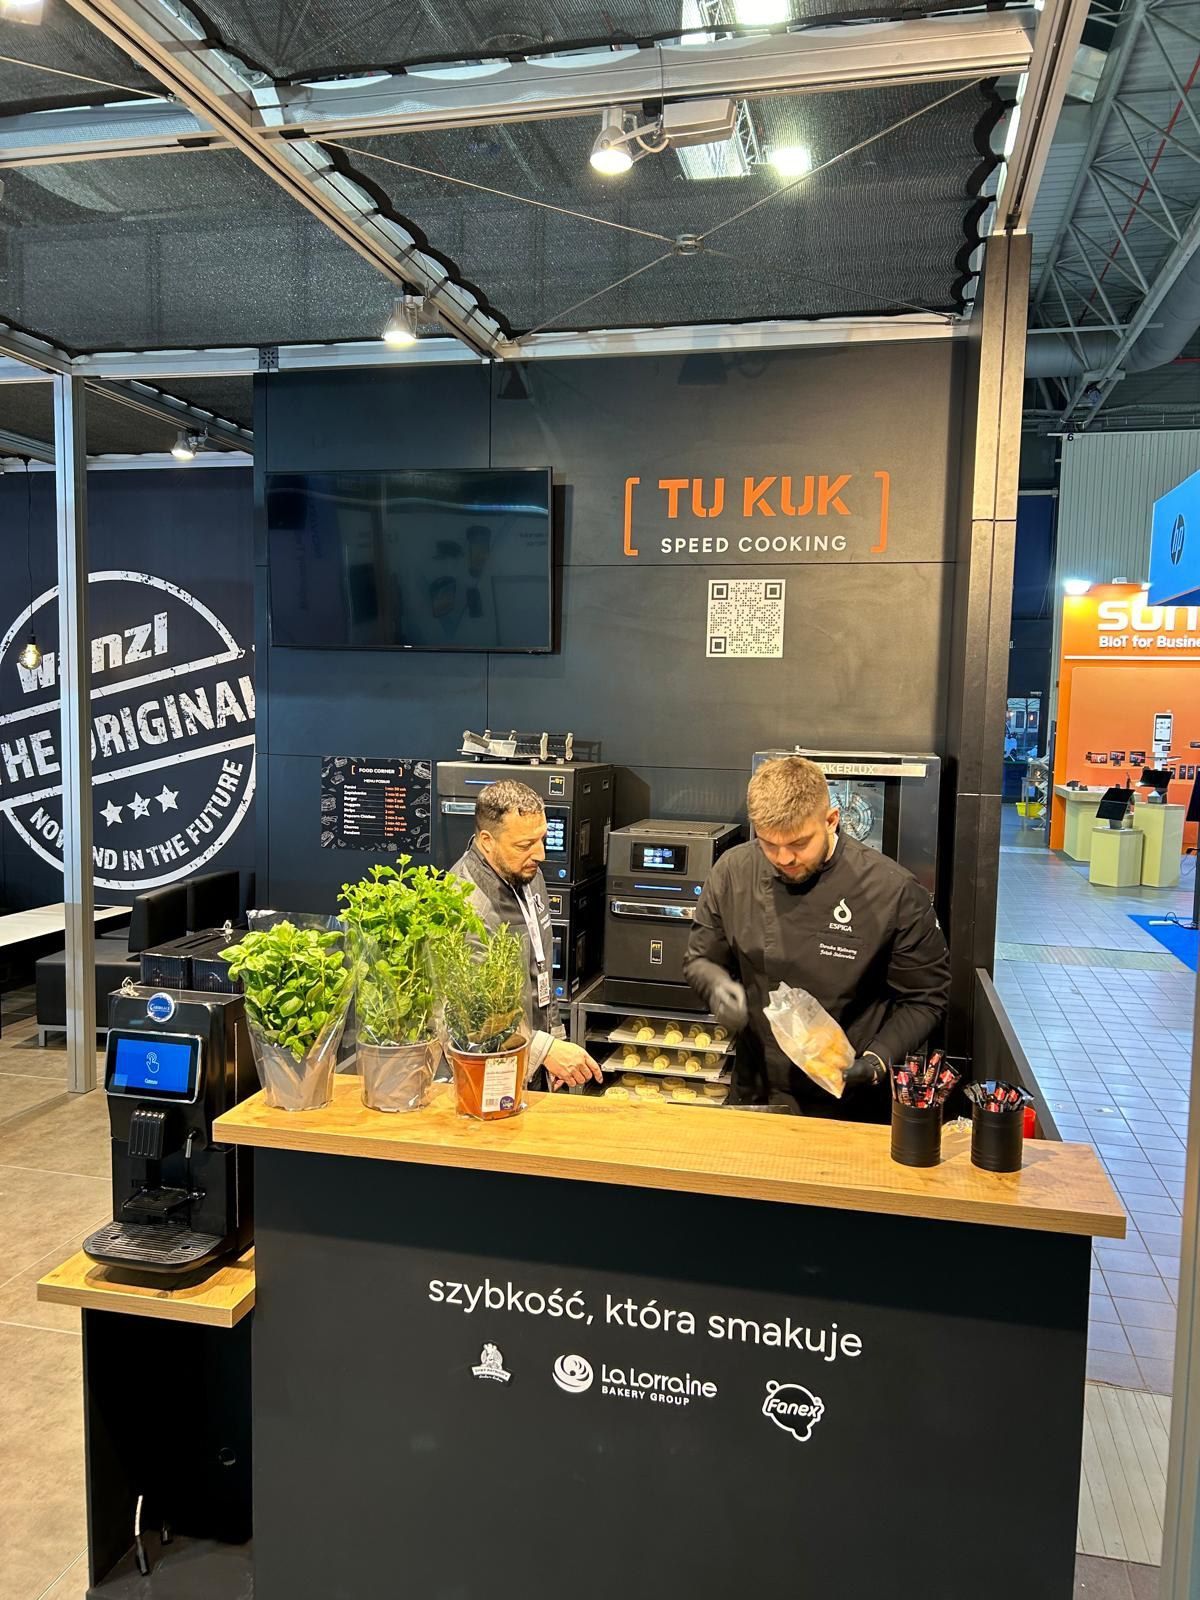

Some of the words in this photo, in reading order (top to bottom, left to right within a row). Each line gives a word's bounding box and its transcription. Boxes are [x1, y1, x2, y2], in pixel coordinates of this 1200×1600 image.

[658, 477, 725, 518] TU
[743, 475, 852, 517] KUK
[661, 537, 729, 553] SPEED
[738, 535, 847, 552] COOKING
[17, 612, 168, 694] wnzl
[1132, 634, 1153, 648] for
[0, 729, 61, 786] HE
[91, 675, 256, 761] RIGINAL
[821, 764, 875, 775] AKERLUX
[92, 846, 118, 870] ND
[123, 845, 145, 871] IN
[146, 833, 190, 867] THE
[186, 758, 244, 846] FUTURE
[829, 922, 852, 932] ESPIGA
[429, 1279, 594, 1326] szybkość,
[606, 1294, 696, 1335] która
[708, 1316, 863, 1362] smakuje
[602, 1363, 627, 1386] La
[629, 1367, 718, 1398] Lorraine
[602, 1385, 645, 1400] BAKERY
[649, 1392, 690, 1406] GROUP
[767, 1398, 820, 1418] Fanex
